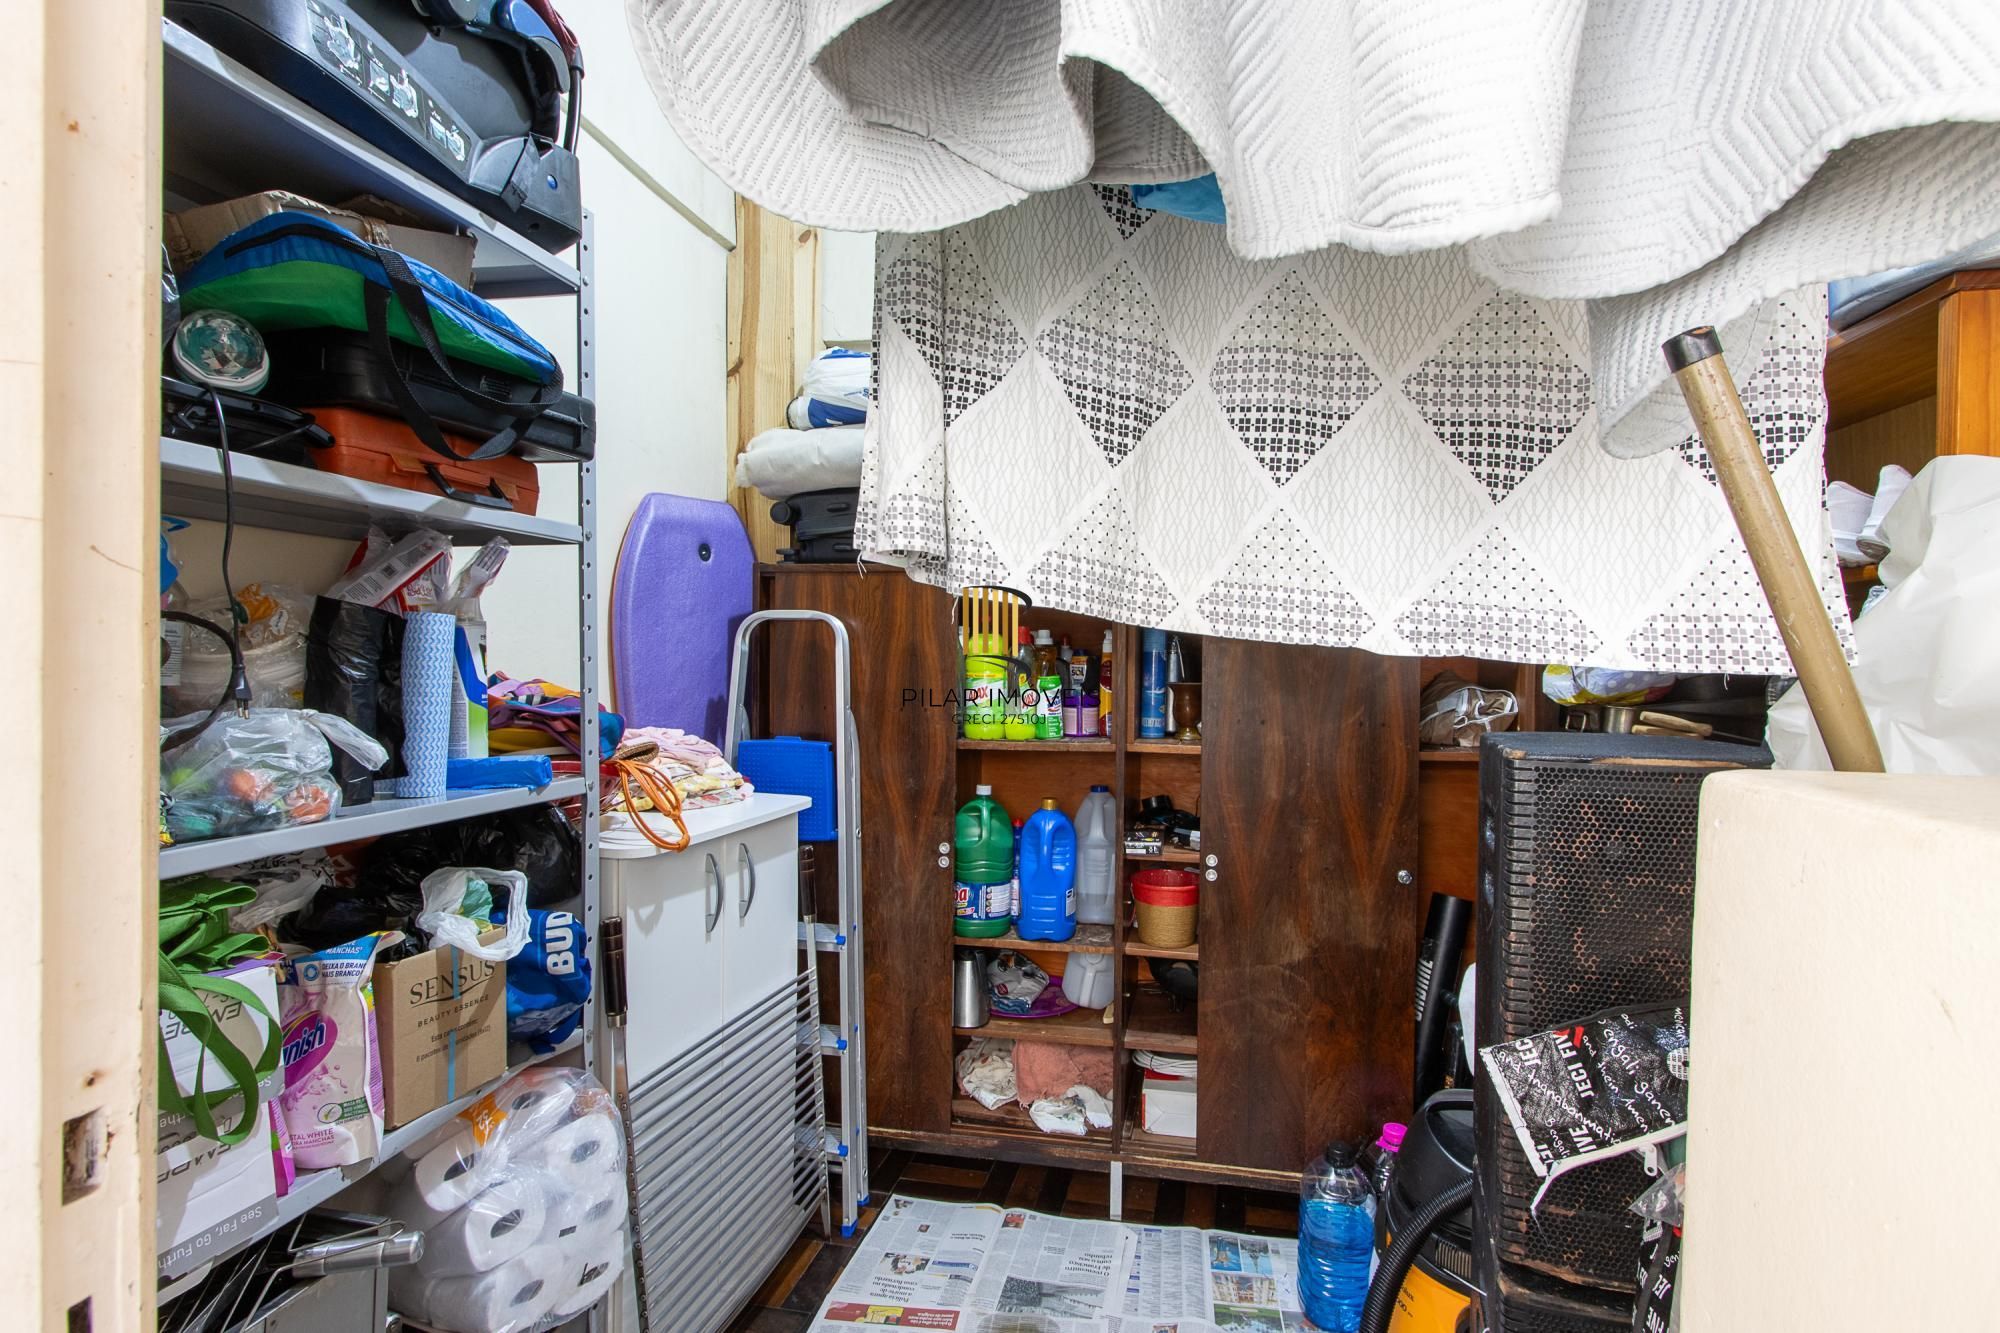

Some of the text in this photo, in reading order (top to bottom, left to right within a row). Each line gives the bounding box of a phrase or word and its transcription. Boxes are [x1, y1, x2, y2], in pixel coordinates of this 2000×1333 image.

[546, 912, 574, 975] BUD
[410, 960, 496, 1004] SENSUS
[417, 994, 489, 1028] BEAUTY ESSENCE
[1562, 1062, 1594, 1098] JECI
[306, 1128, 334, 1139] WHITE
[215, 1220, 238, 1236] Far,
[240, 1206, 262, 1224] See
[195, 1232, 212, 1248] Go
